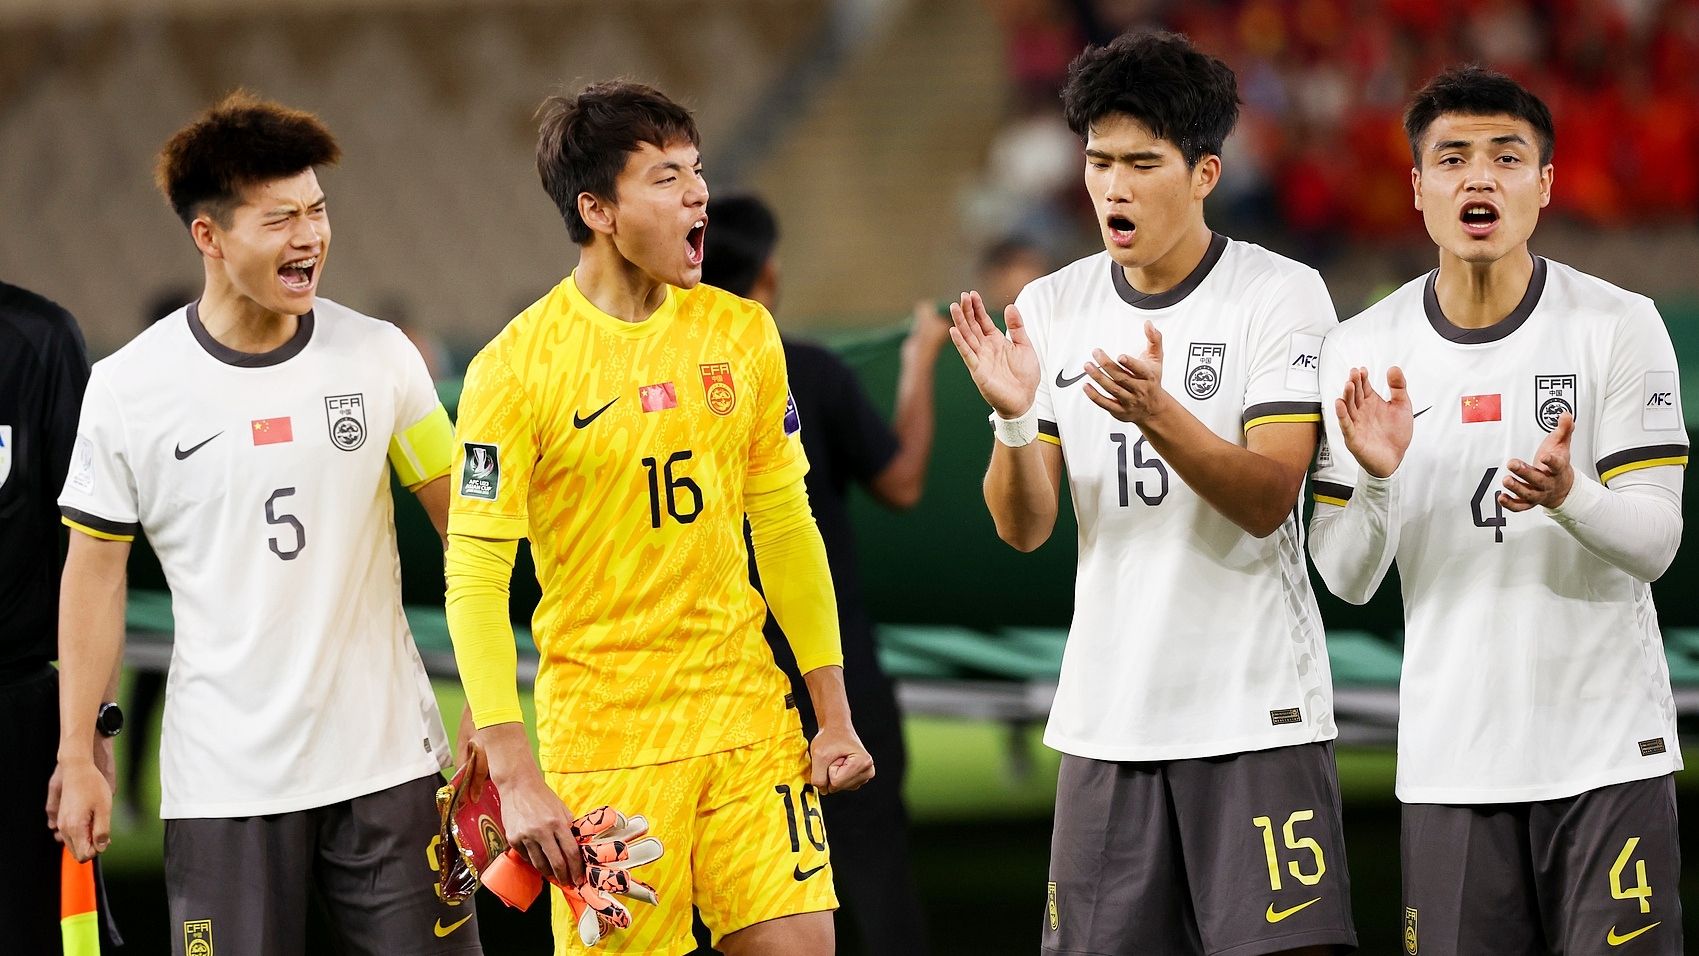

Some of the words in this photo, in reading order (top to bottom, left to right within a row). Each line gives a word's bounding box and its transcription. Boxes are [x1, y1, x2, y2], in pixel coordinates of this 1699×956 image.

[1192, 346, 1222, 357] CFA
[1291, 353, 1318, 369] AFC
[700, 364, 729, 376] CFA
[1539, 378, 1573, 390] CFA
[1549, 389, 1563, 397] 中国
[1646, 392, 1672, 406] AFC
[328, 397, 360, 410] CFA
[1109, 432, 1169, 507] 15
[642, 450, 704, 528] 16
[1470, 467, 1507, 543] 4
[264, 486, 306, 561] 5
[774, 783, 826, 852] 16
[1252, 809, 1327, 891] 15
[1608, 836, 1653, 914] 4
[187, 923, 209, 934] CFA
